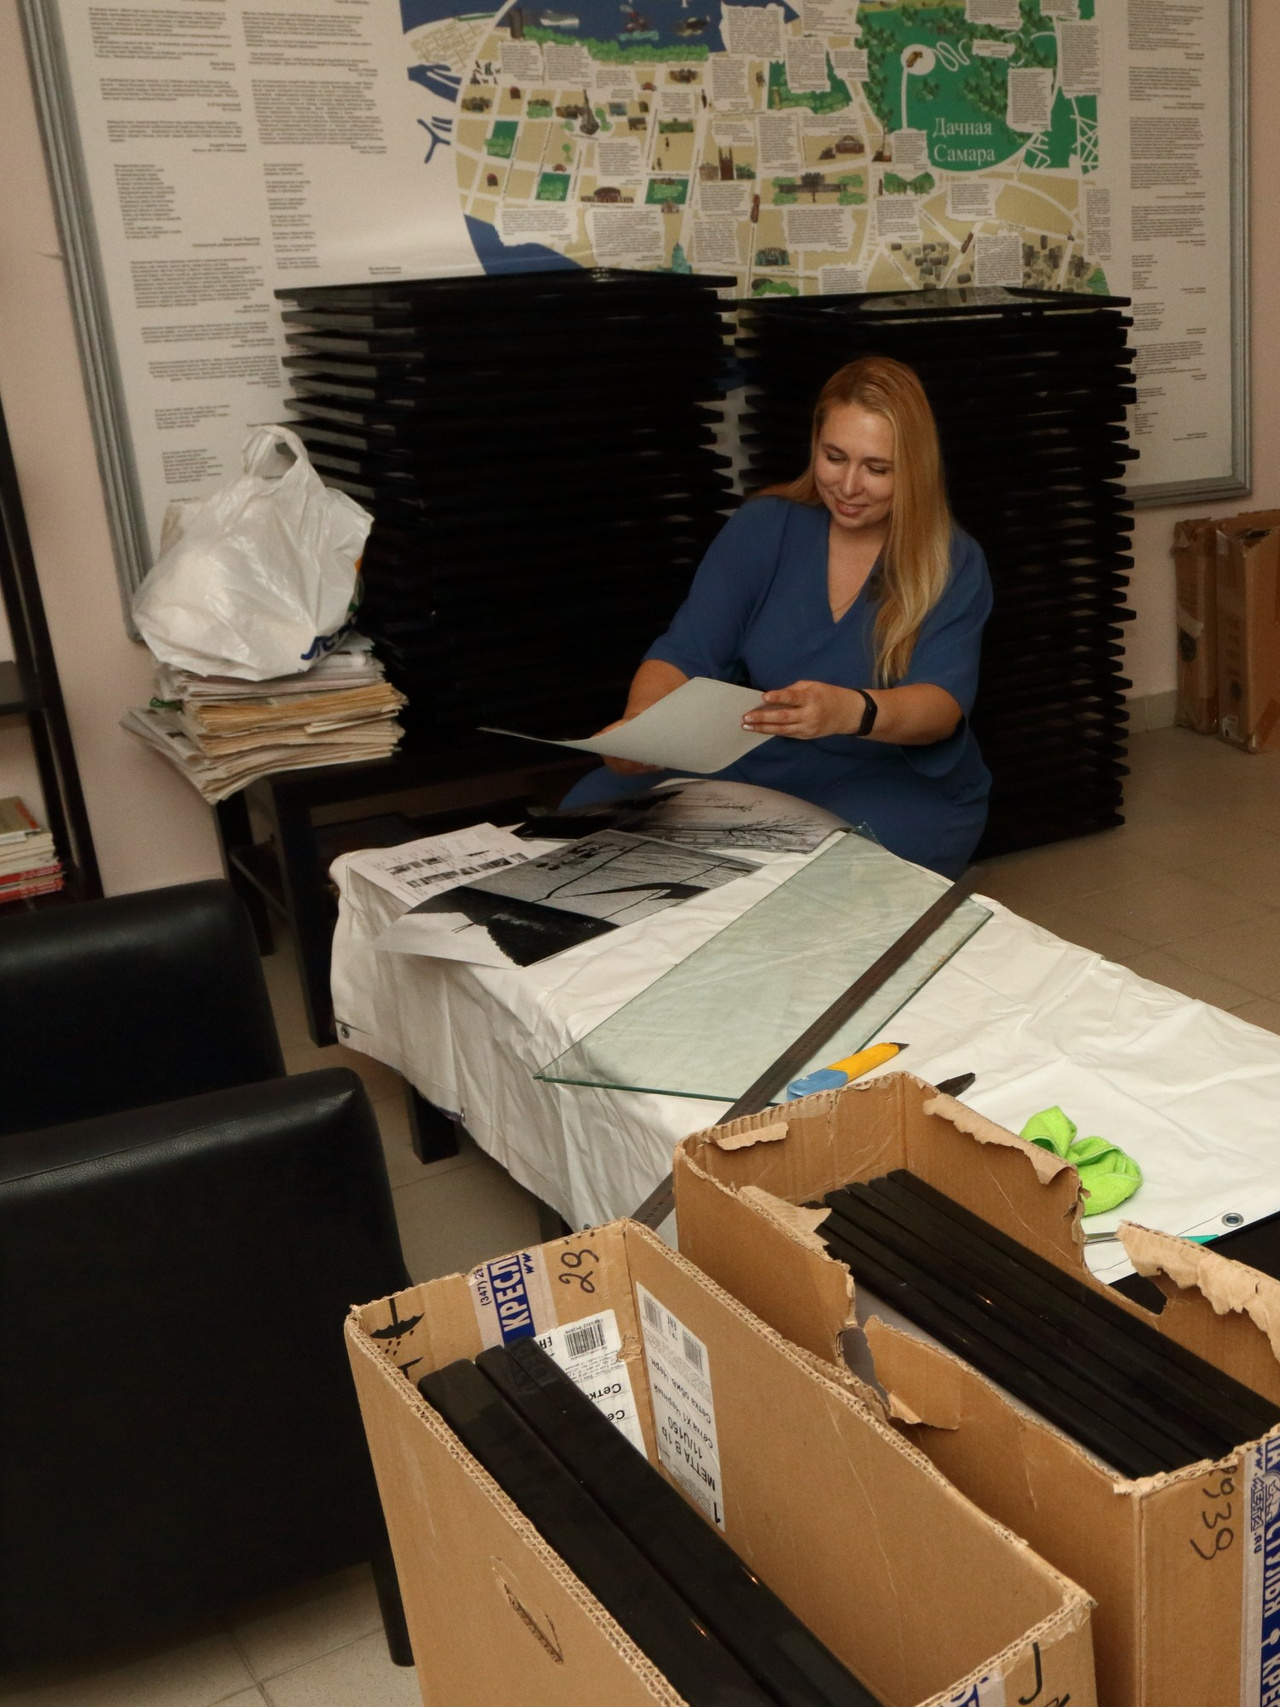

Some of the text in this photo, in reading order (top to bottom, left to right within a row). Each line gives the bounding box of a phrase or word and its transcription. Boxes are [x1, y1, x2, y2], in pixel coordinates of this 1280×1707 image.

[933, 117, 992, 138] Дачная
[934, 145, 995, 166] Самара
[477, 1279, 492, 1306] (347)
[489, 1255, 531, 1332] КРЕСЛ
[586, 1382, 622, 1401] Сетк
[690, 1397, 711, 1424] Сетка
[692, 1422, 713, 1449] Сетка
[684, 1448, 716, 1492] МЕТТА
[713, 1501, 721, 1524] 1
